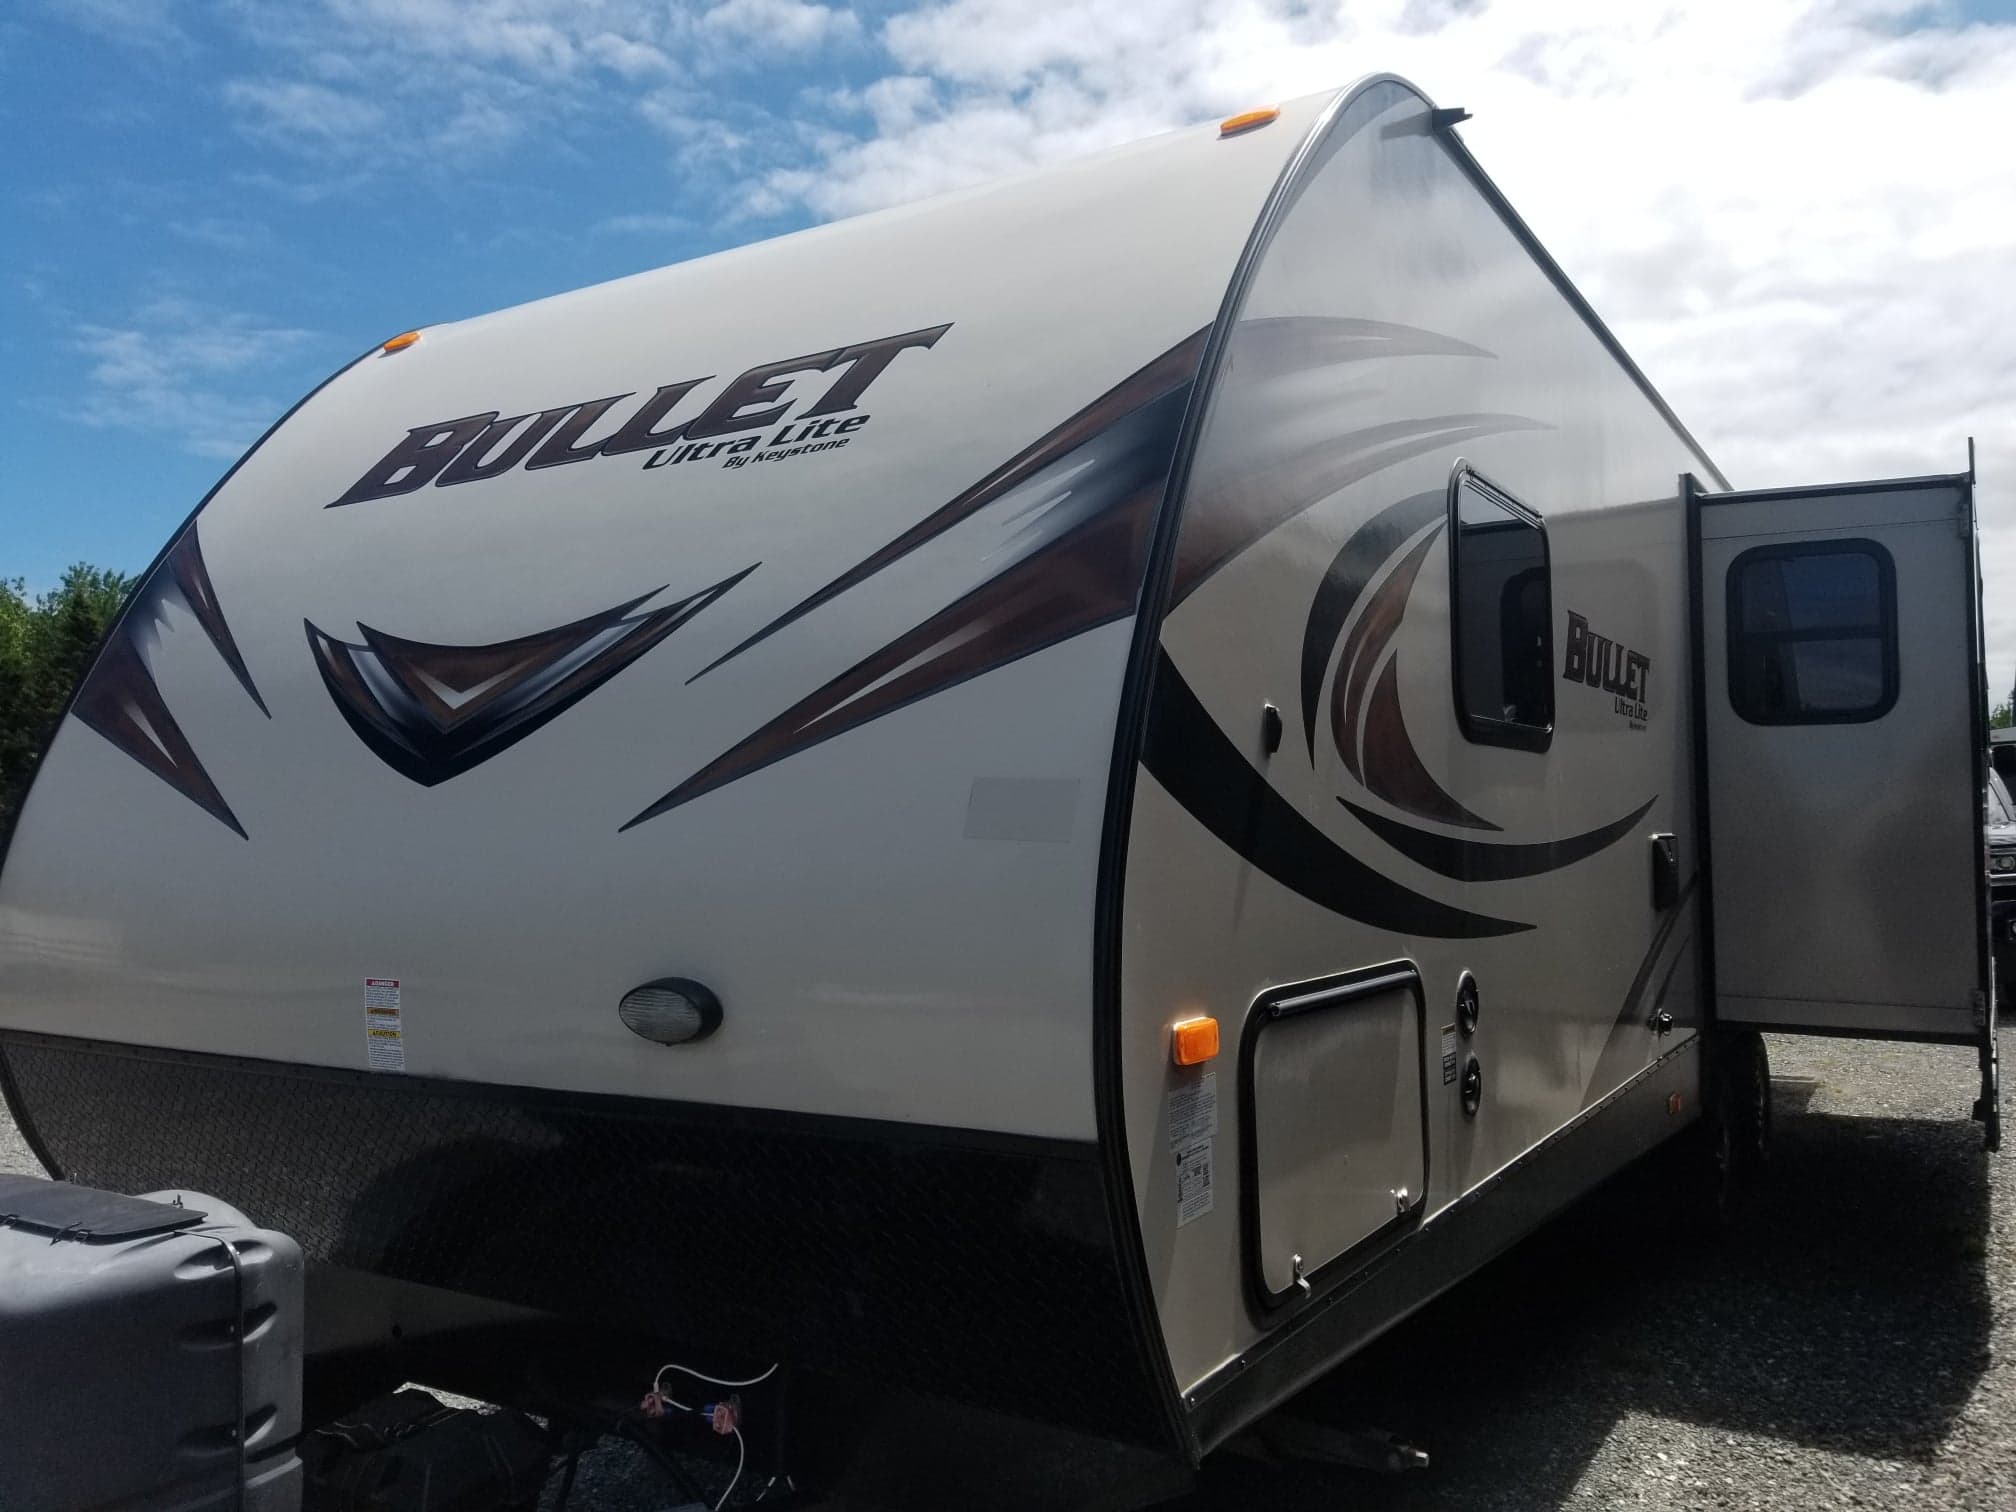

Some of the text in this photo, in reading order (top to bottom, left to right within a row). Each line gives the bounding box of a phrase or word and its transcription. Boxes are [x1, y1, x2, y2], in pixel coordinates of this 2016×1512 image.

[323, 322, 955, 509] BULLET
[642, 415, 871, 470] Ultra Lite
[722, 438, 850, 470] By Keystone
[1563, 610, 1651, 704] BULLET
[1615, 696, 1648, 721] Ultra Lite
